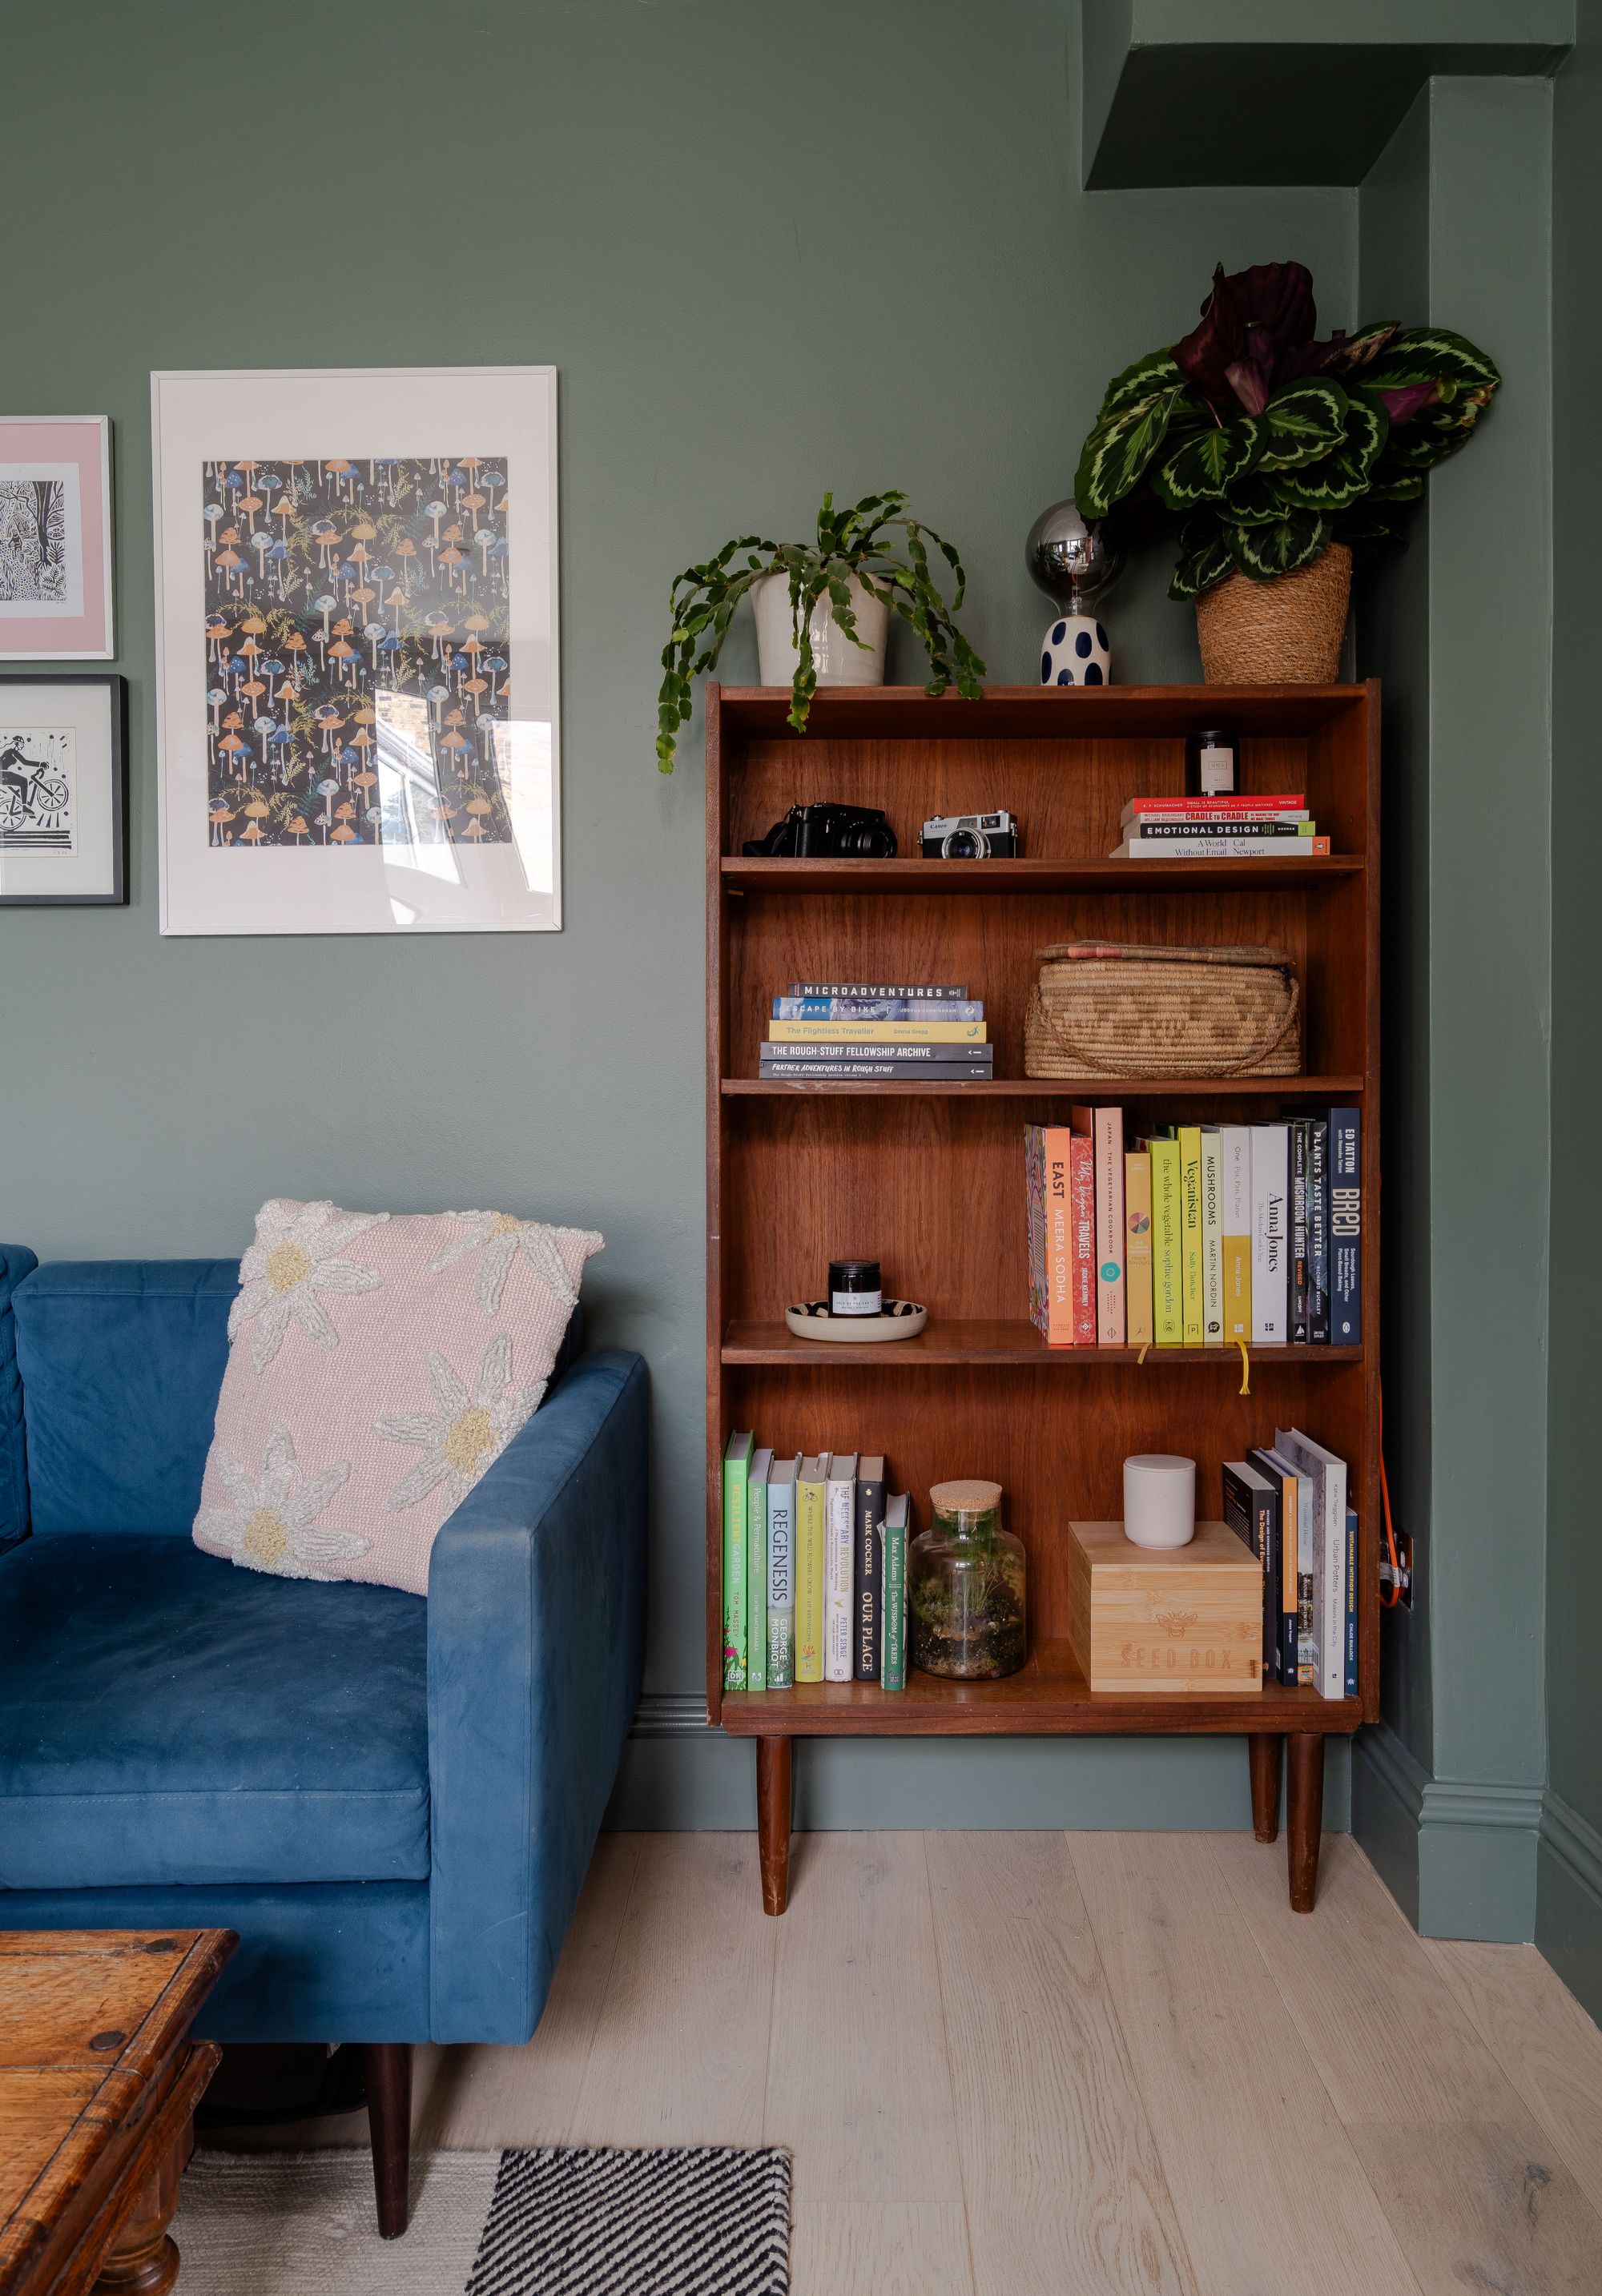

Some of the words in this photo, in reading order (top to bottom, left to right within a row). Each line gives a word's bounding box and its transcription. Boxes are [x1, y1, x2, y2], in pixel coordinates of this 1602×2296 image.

[1147, 826, 1213, 834] EMOTIONAL
[1217, 826, 1259, 834] DESIGN
[1185, 812, 1213, 820] CRADLE
[1221, 812, 1249, 820] CRADLE
[1175, 848, 1205, 856] Without
[1206, 847, 1227, 856] Email
[1205, 839, 1227, 847] World
[1234, 847, 1265, 857] Newport
[804, 986, 942, 997] MICROADVENTURES
[803, 1027, 839, 1035] Flightless
[841, 1027, 874, 1035] Traveller
[772, 1046, 787, 1055] THE
[790, 1047, 844, 1056] ROUGH-STUFF
[846, 1047, 895, 1056] FELLOWSHIP
[896, 1047, 931, 1057] ARCHIVE
[801, 1064, 842, 1072] ADVENTURES
[852, 1065, 873, 1073] ROUGH
[1345, 1129, 1354, 1140] ED
[1074, 1159, 1093, 1182] My
[1163, 1160, 1172, 1168] the
[1345, 1142, 1354, 1172] TATTON
[1053, 1162, 1065, 1198] EAST
[1164, 1176, 1173, 1202] whole
[1184, 1160, 1198, 1228] Veganistan
[1207, 1156, 1216, 1225] MUSHROOMS
[1314, 1178, 1322, 1211] TASTE
[1077, 1185, 1093, 1218] Vegan
[1269, 1192, 1283, 1232] Anna
[1294, 1177, 1304, 1224] MUSHROOM
[1054, 1209, 1065, 1251] MEERA
[1079, 1220, 1089, 1258] TRAVELS
[1162, 1205, 1173, 1246] vegetable
[1314, 1216, 1322, 1257] BETTER
[1265, 1233, 1283, 1273] Jones
[1294, 1226, 1305, 1258] HUNTER
[1163, 1249, 1173, 1279] sophie
[1189, 1252, 1197, 1269] Sally
[1055, 1257, 1065, 1303] SODHA
[1210, 1273, 1218, 1308] NORDIN
[1163, 1281, 1173, 1313] gordon
[753, 1488, 761, 1514] People
[840, 1486, 849, 1499] THE
[773, 1510, 787, 1601] REGENESIS
[840, 1547, 849, 1593] REVOLUTION
[862, 1592, 872, 1623] OUR
[771, 1618, 779, 1668] MONBIOT
[862, 1627, 872, 1672] PLACE
[1121, 1647, 1177, 1668] SEED
[1189, 1649, 1231, 1669] BOX
